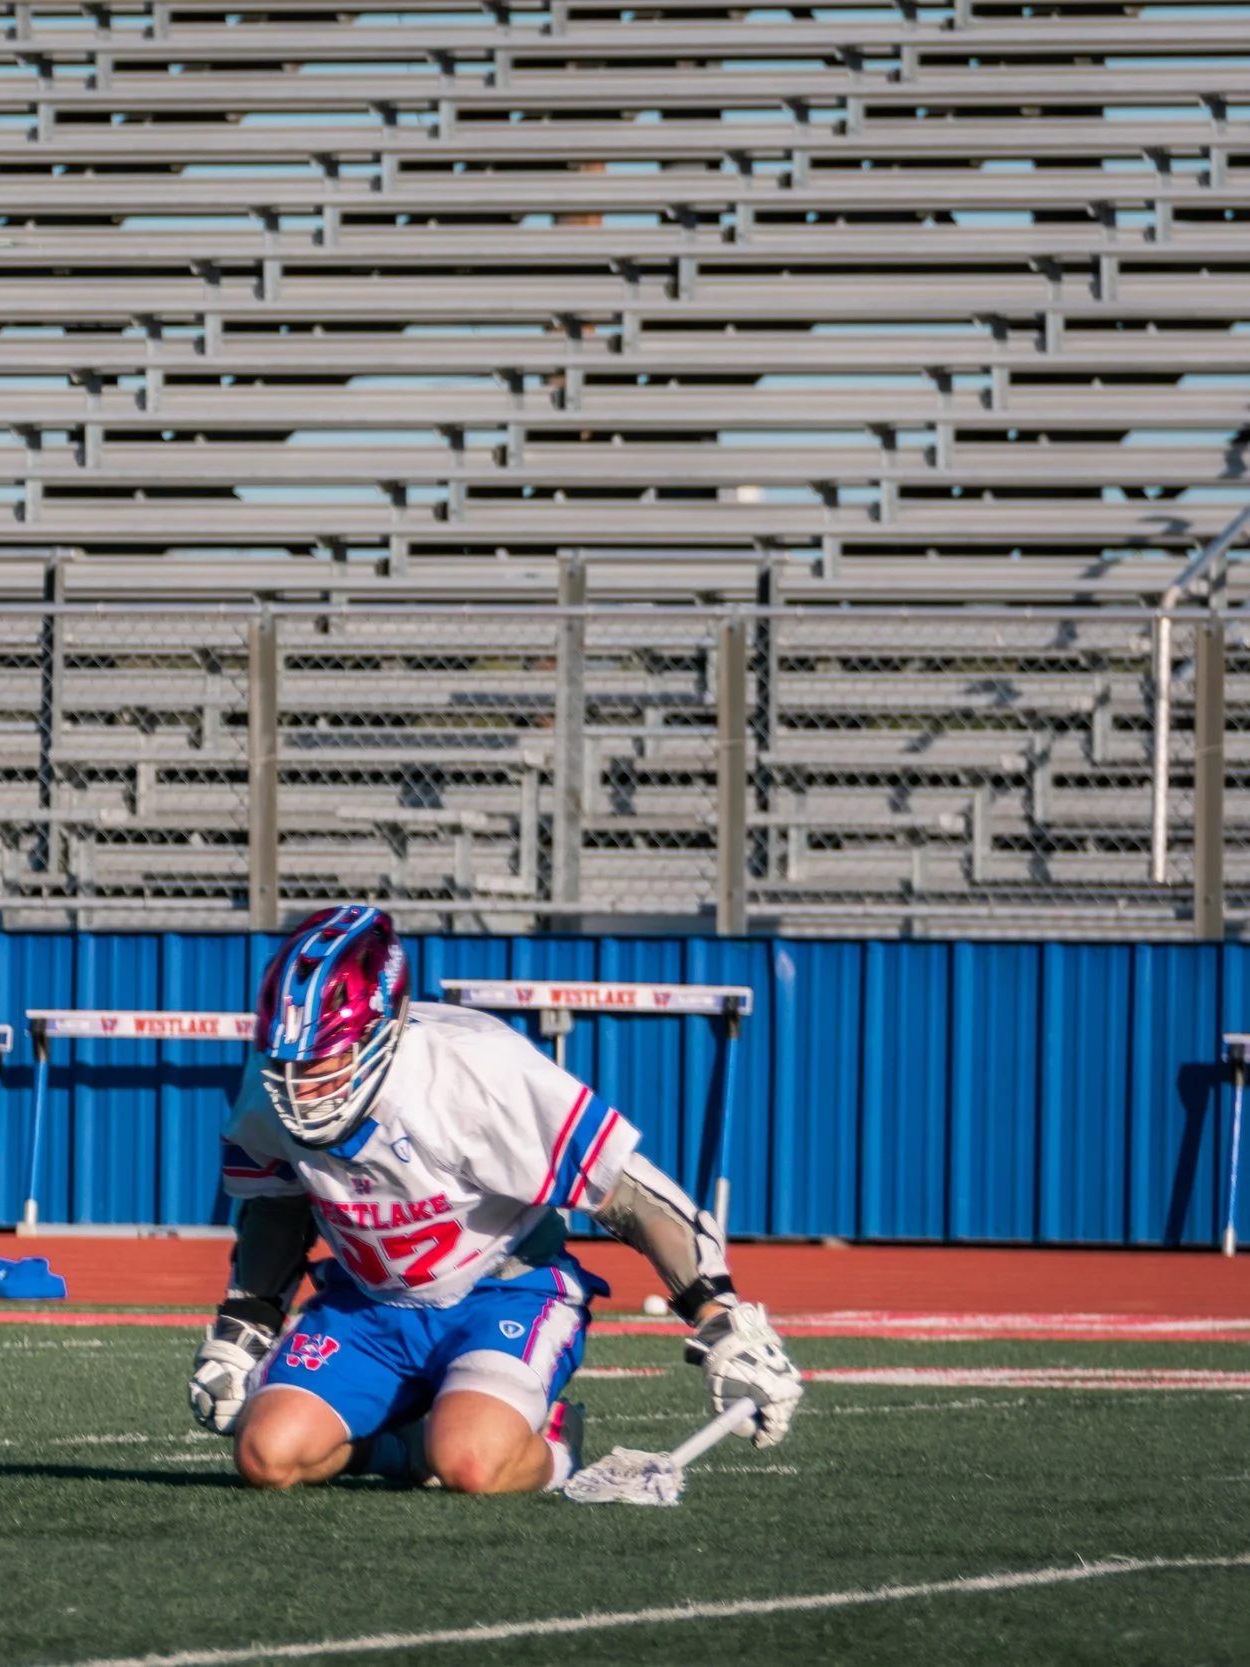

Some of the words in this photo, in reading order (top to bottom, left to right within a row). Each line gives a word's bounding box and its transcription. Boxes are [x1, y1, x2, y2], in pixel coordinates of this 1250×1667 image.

[550, 988, 637, 1007] WESTLAKE
[134, 1018, 219, 1034] WESTLAKE
[308, 1192, 452, 1231] ESTLAKE
